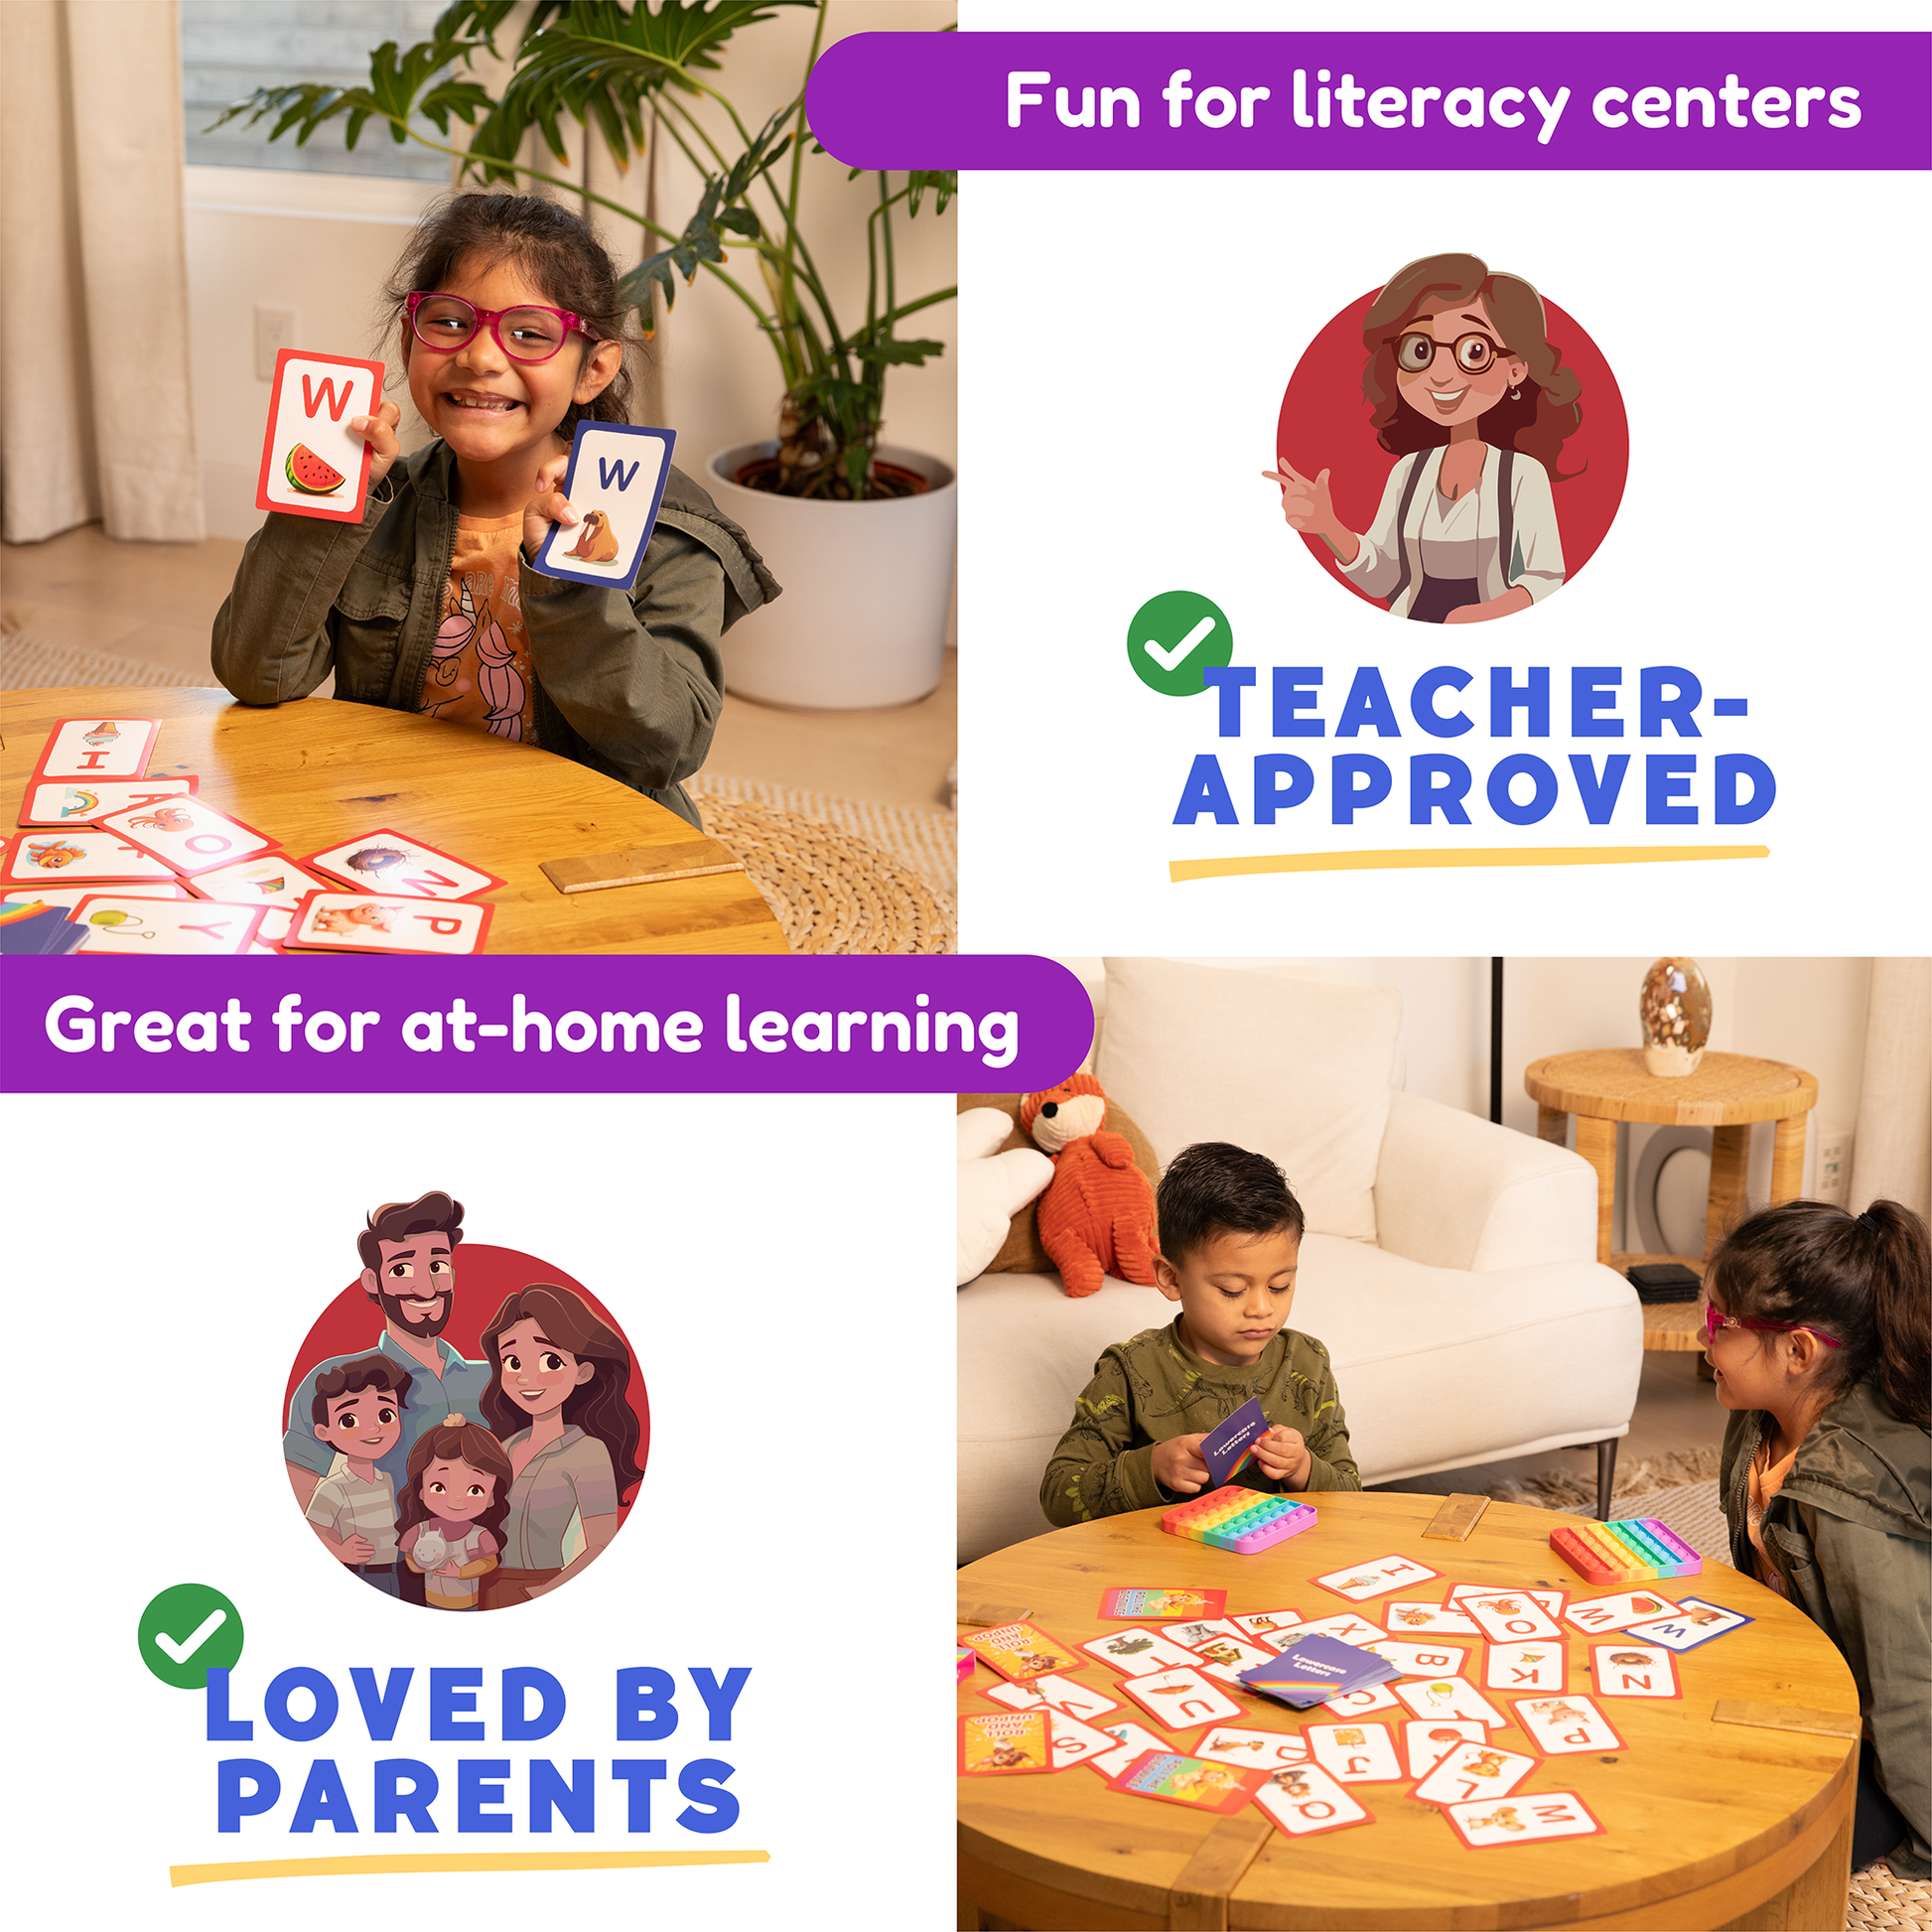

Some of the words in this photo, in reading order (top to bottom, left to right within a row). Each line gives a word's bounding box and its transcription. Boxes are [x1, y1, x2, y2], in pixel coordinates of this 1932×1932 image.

[302, 373, 354, 422] W
[185, 834, 232, 855] O
[178, 921, 232, 940] Y
[412, 914, 463, 935] P
[1213, 1421, 1256, 1456] Lowercase
[1221, 1431, 1251, 1455] Letters
[973, 1625, 1023, 1642] UNPOP
[1328, 1622, 1367, 1636] X
[1505, 1619, 1537, 1634] O
[991, 1632, 1021, 1645] AND
[997, 1638, 1032, 1651] ROLL
[1292, 1653, 1347, 1675] Lowercase
[1415, 1653, 1449, 1667] B
[1294, 1661, 1331, 1677] Letters
[1510, 1667, 1539, 1684] K
[1178, 1700, 1215, 1718] U
[975, 1715, 1034, 1725] UNPOP
[986, 1728, 1025, 1737] ROLL
[1563, 1727, 1591, 1744] P
[1052, 1736, 1088, 1754] S
[1292, 1801, 1336, 1820] Q
